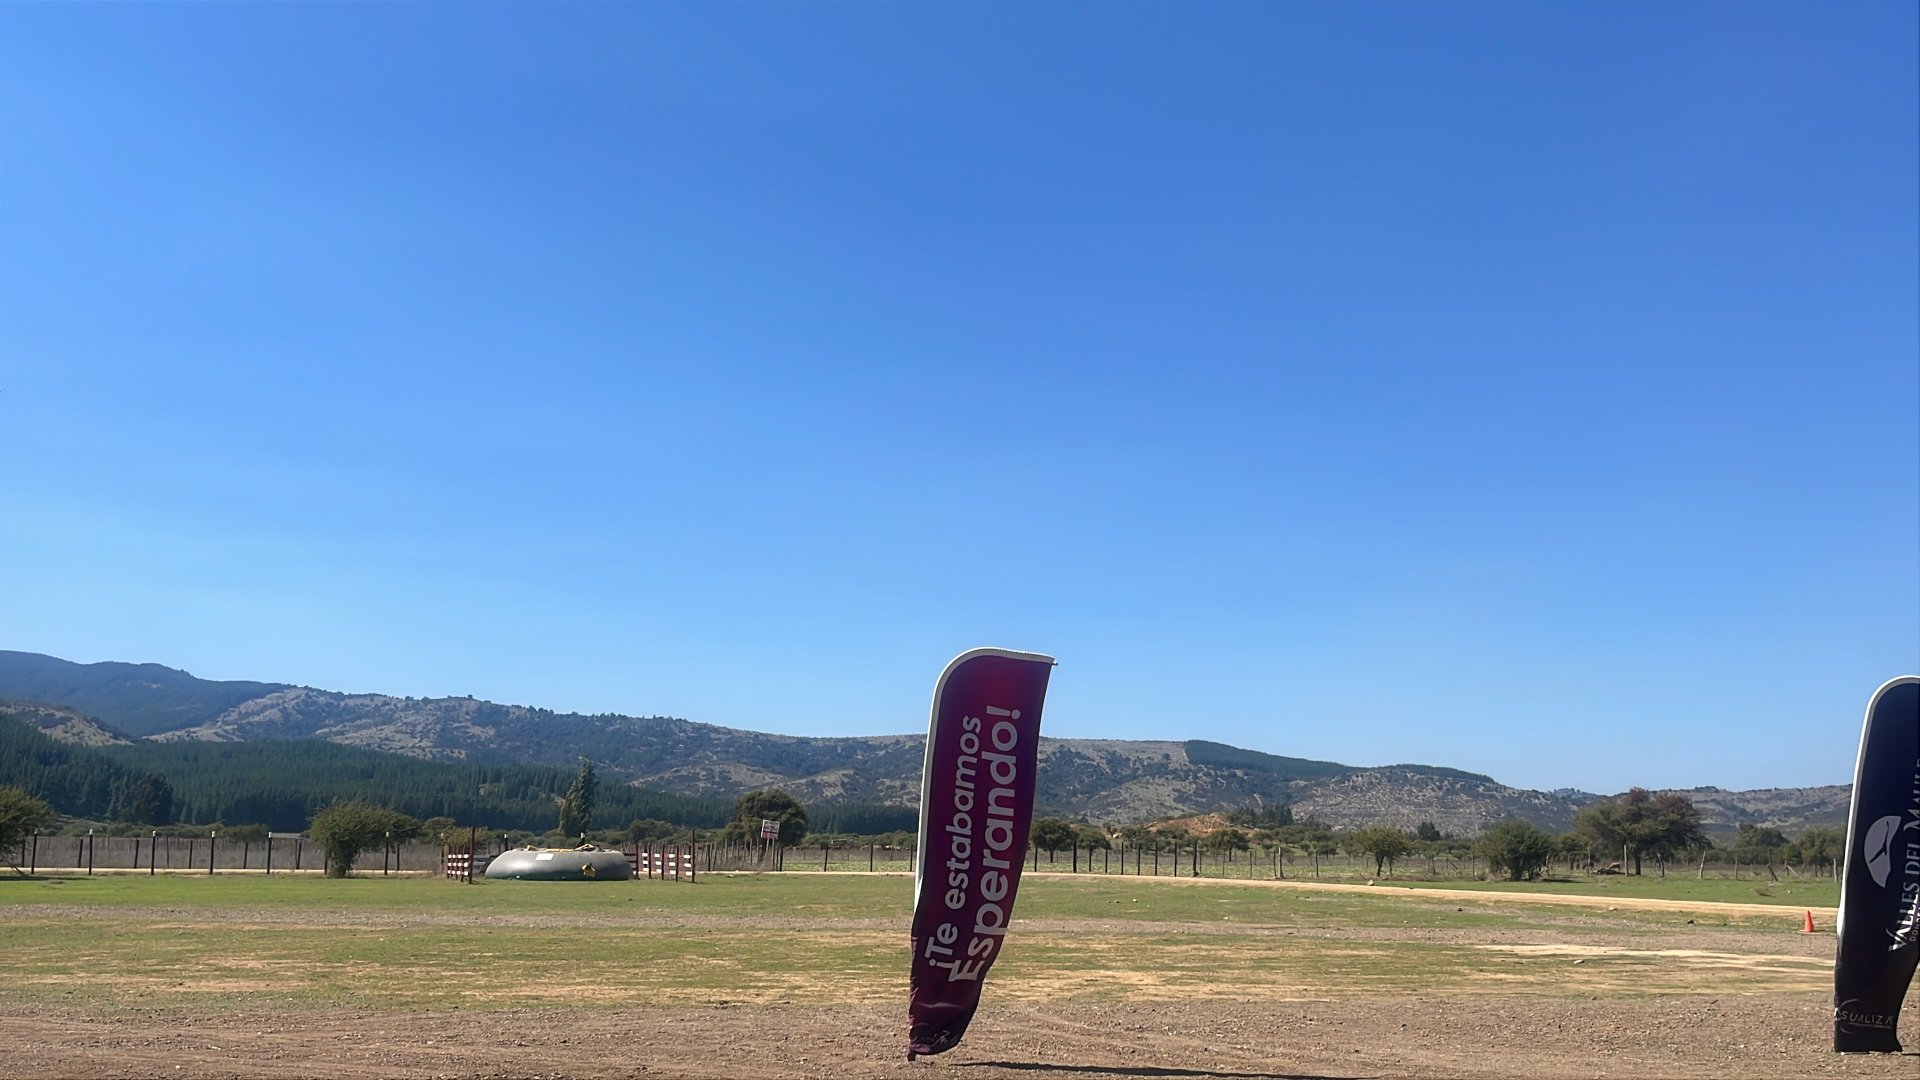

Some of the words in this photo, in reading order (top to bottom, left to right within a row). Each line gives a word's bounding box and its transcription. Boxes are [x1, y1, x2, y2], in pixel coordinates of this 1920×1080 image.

[924, 923, 957, 969] ¡Te
[945, 715, 981, 909] estabamos
[948, 706, 1021, 982] Esperando!
[1886, 883, 1920, 952] VALLES
[1837, 1009, 1894, 1025] SUALIZA
